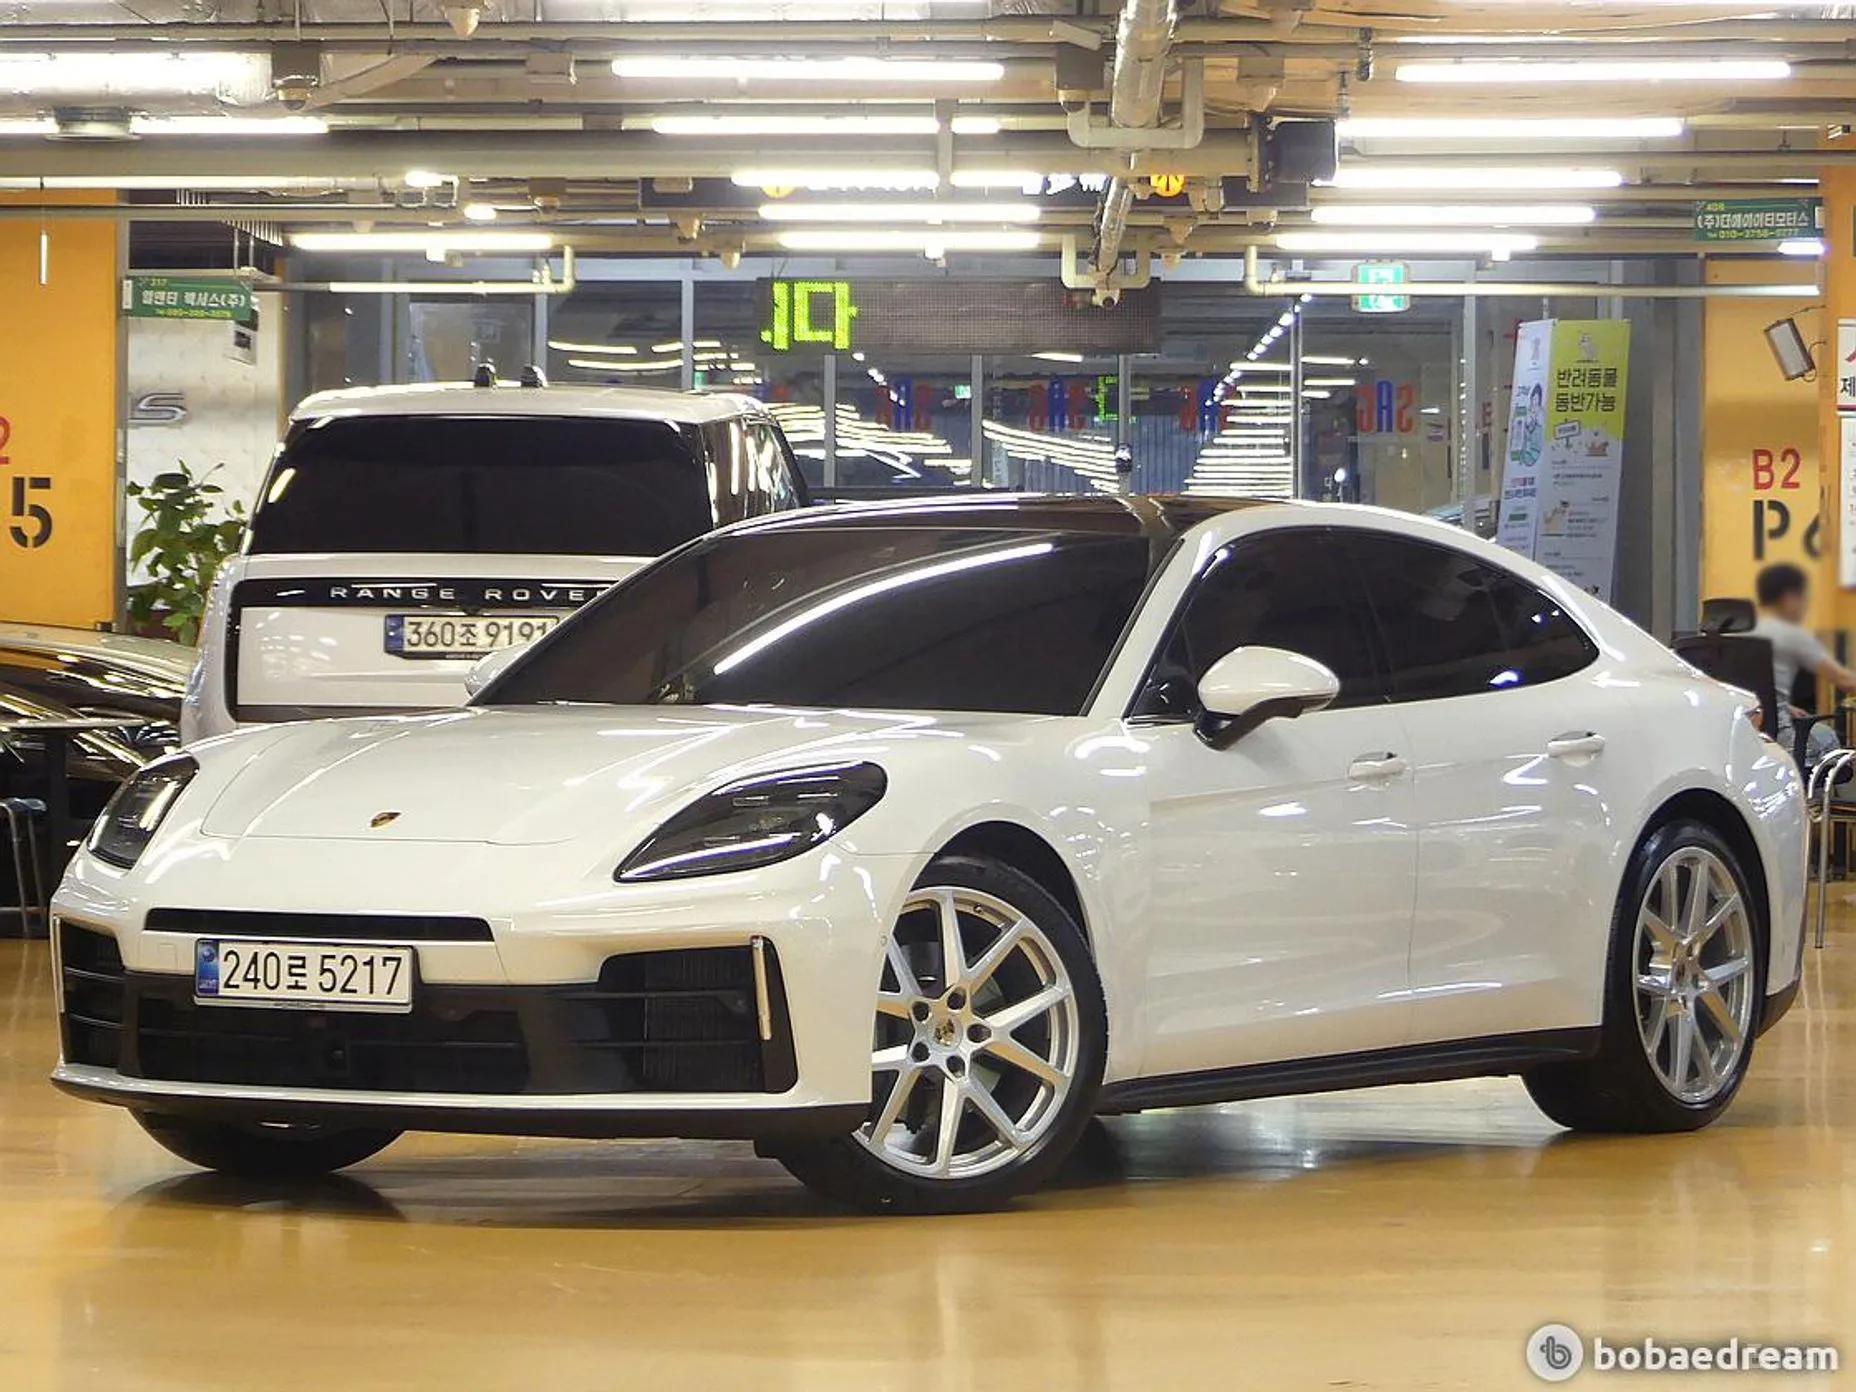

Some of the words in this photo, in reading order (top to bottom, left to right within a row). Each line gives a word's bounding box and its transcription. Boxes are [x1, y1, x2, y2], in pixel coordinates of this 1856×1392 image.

[1556, 367, 1618, 388] 반려동물
[1555, 392, 1616, 413] 동반가능
[1753, 449, 1801, 490] B2
[330, 588, 456, 600] RANGE
[484, 589, 603, 601] ROVE
[406, 621, 477, 648] 360조
[222, 949, 307, 991] 240로
[318, 954, 402, 995] 5217
